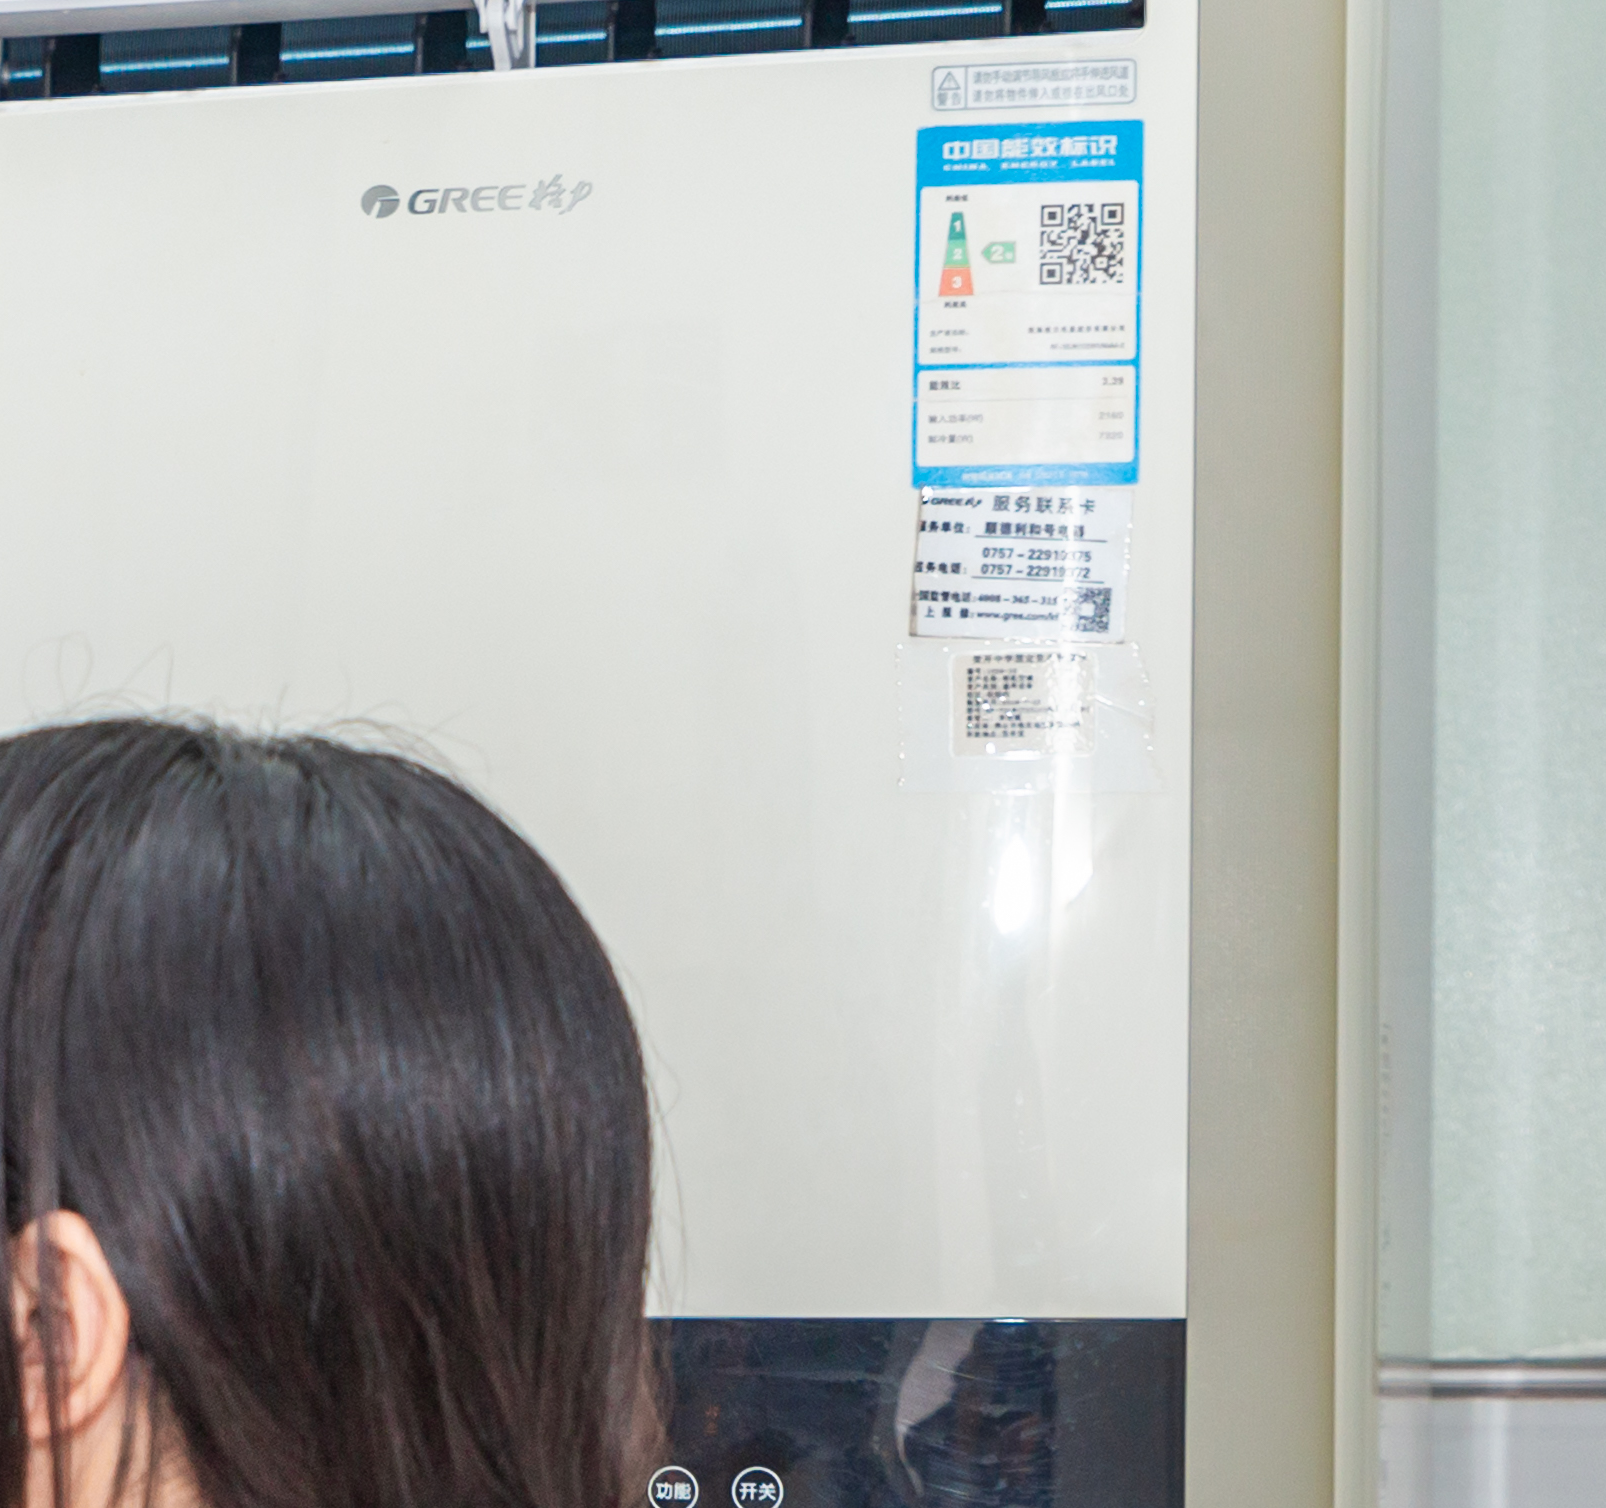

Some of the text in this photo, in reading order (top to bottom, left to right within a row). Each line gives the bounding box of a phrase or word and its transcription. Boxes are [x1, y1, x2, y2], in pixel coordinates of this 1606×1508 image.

[942, 134, 1118, 161] 中国能效标识
[407, 184, 527, 215] GREE
[655, 1482, 777, 1501] 功能 开关
